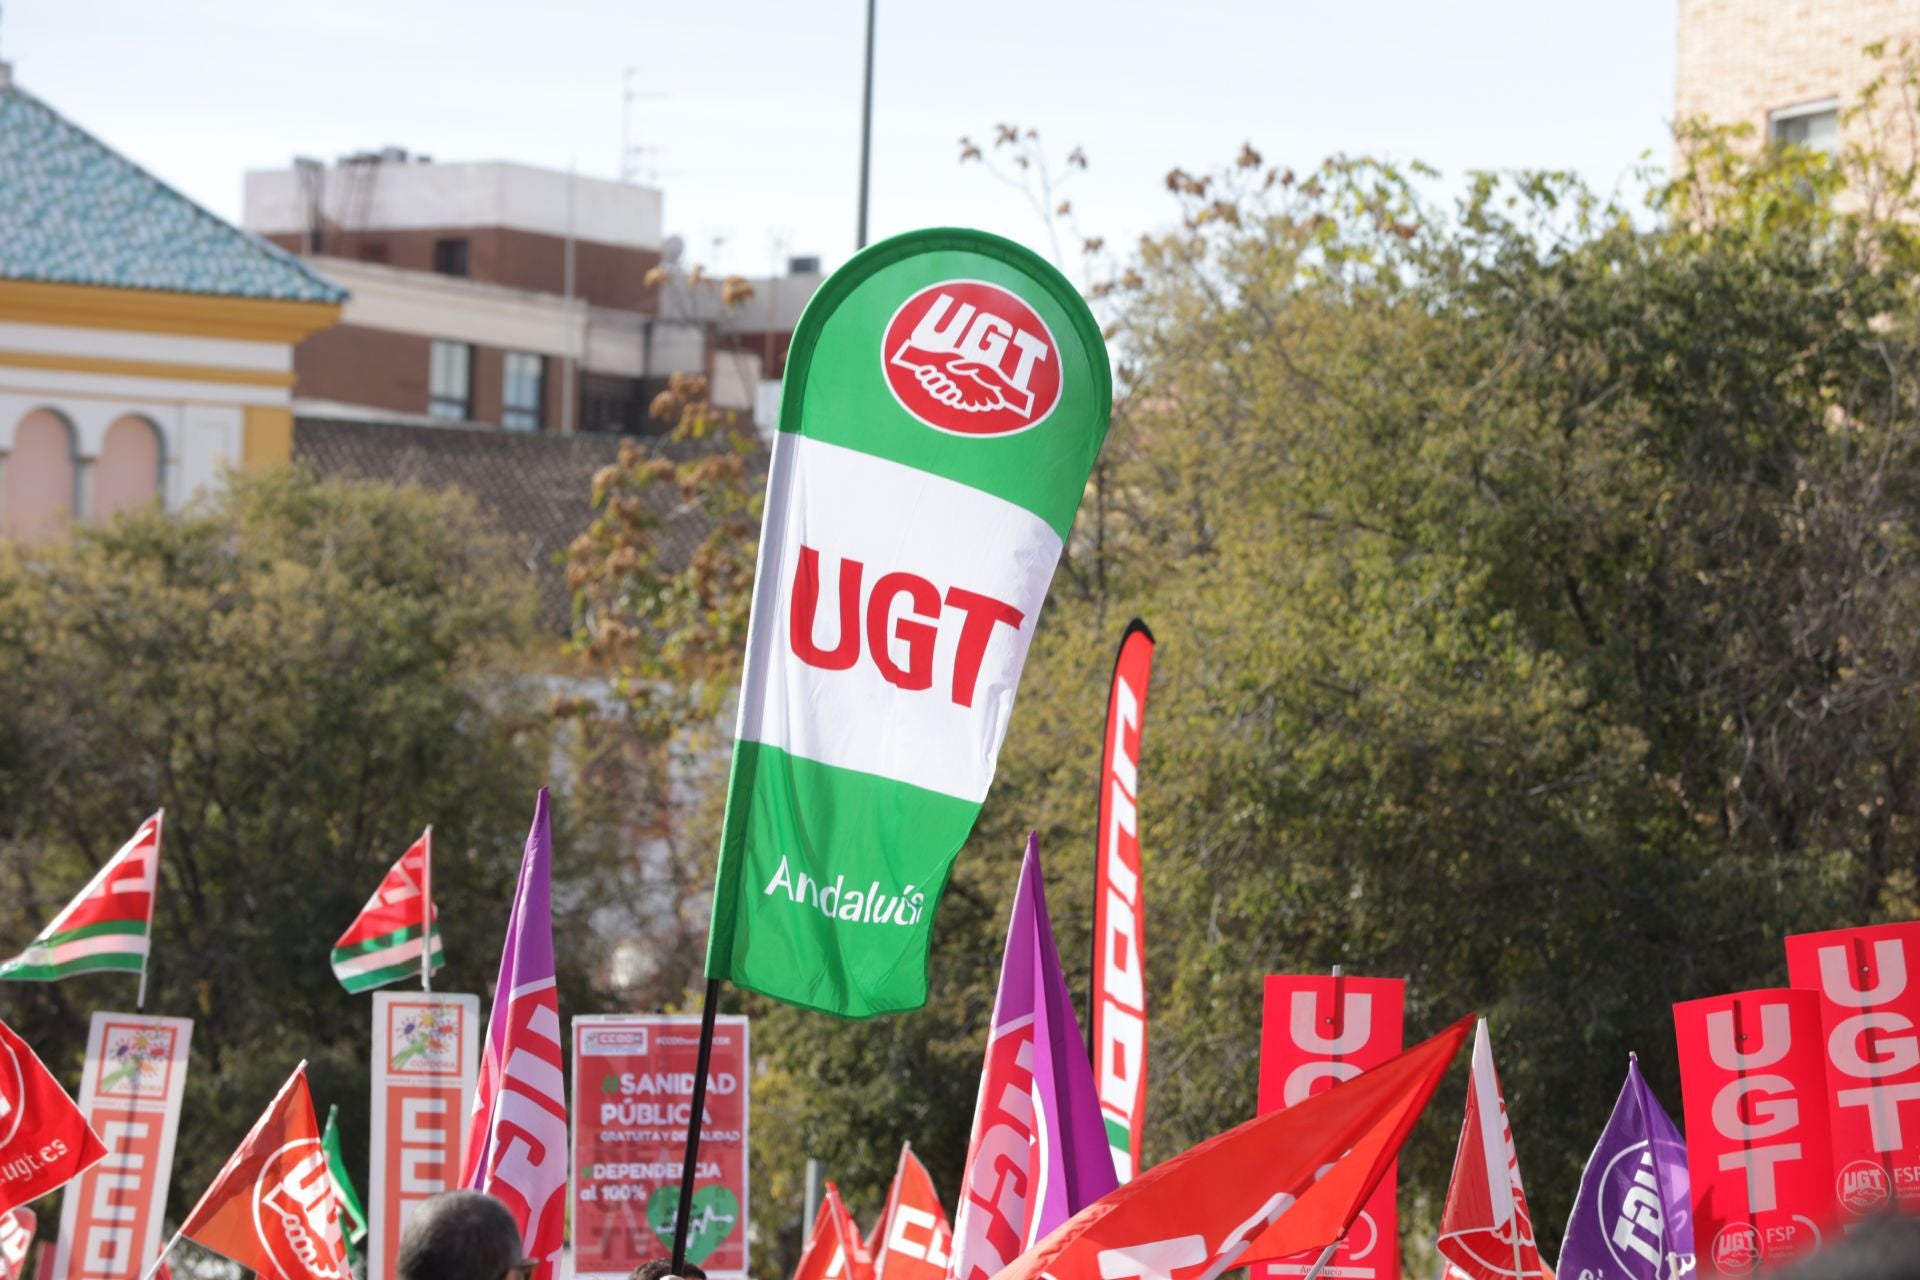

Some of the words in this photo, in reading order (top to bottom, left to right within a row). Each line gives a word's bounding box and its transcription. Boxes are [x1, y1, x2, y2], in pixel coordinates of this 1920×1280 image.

[913, 293, 1048, 382] UGT
[788, 545, 1024, 708] UGT
[1818, 938, 1920, 1154] UGT
[602, 1073, 737, 1095] #SANIDAD
[600, 1097, 713, 1126] PÚBLICA
[1706, 1003, 1801, 1214] UGT
[580, 1185, 598, 1201] al
[602, 1184, 647, 1201] 100%
[1843, 1170, 1881, 1193] UGT
[82, 1120, 150, 1280] CCO
[1718, 1230, 1757, 1251] UGT
[1766, 1225, 1796, 1243] FSP
